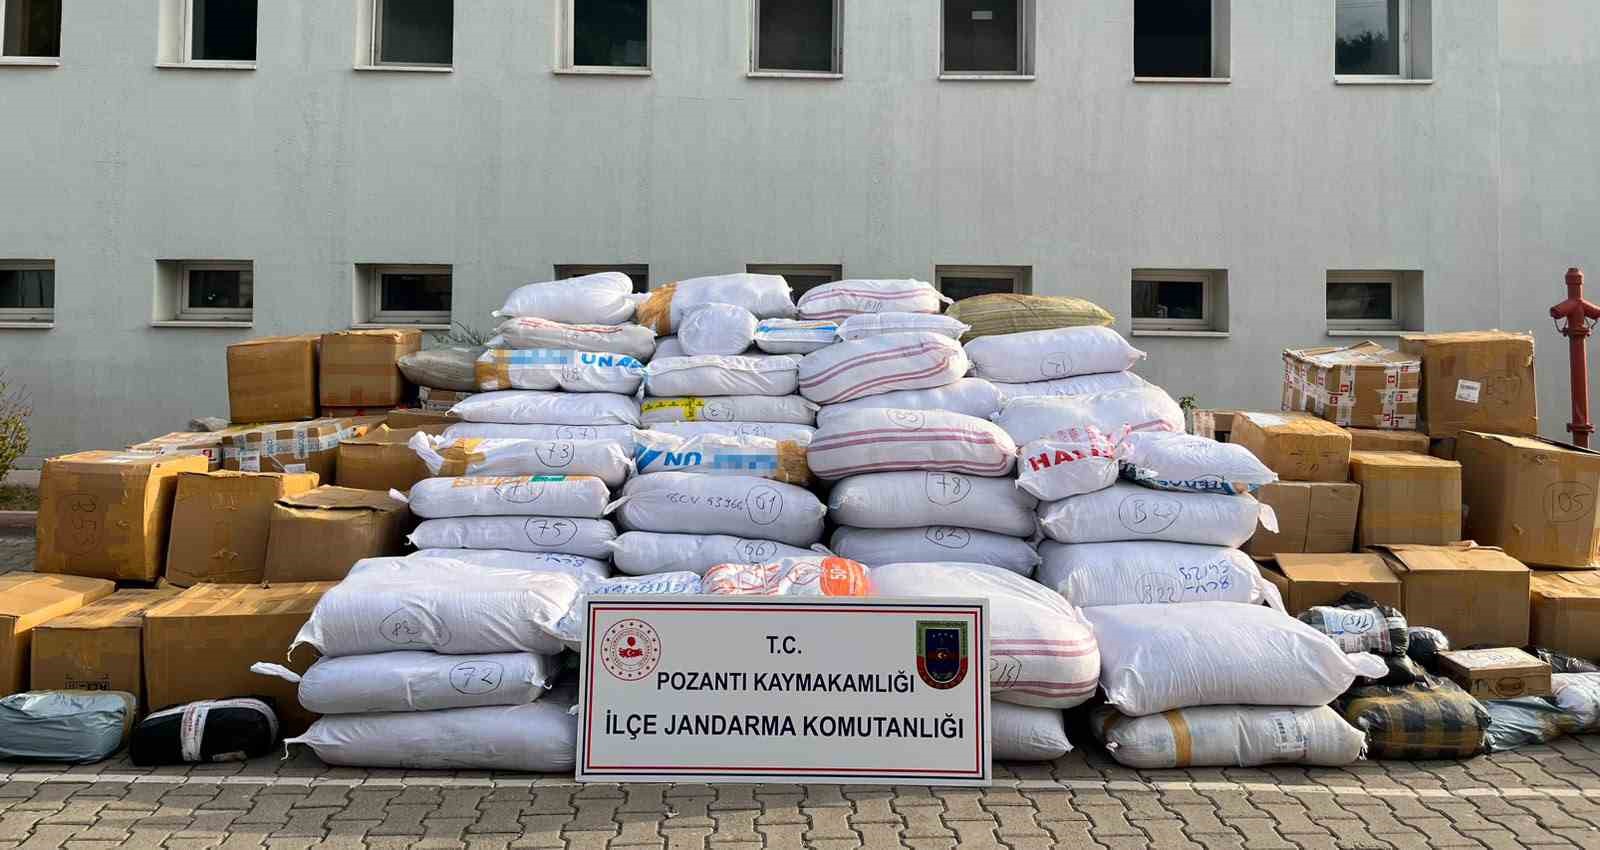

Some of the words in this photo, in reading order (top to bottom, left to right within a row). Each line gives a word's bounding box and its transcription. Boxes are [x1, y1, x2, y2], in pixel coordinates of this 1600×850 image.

[531, 519, 567, 538] 75
[765, 635, 802, 655] T.C.
[657, 671, 747, 691] POZANTI
[754, 670, 915, 693] KAYMAKAMLIĞI
[605, 709, 657, 741] İLÇE
[664, 714, 797, 737] JANDARMA
[803, 712, 964, 739] KOMUTANLIĞI
